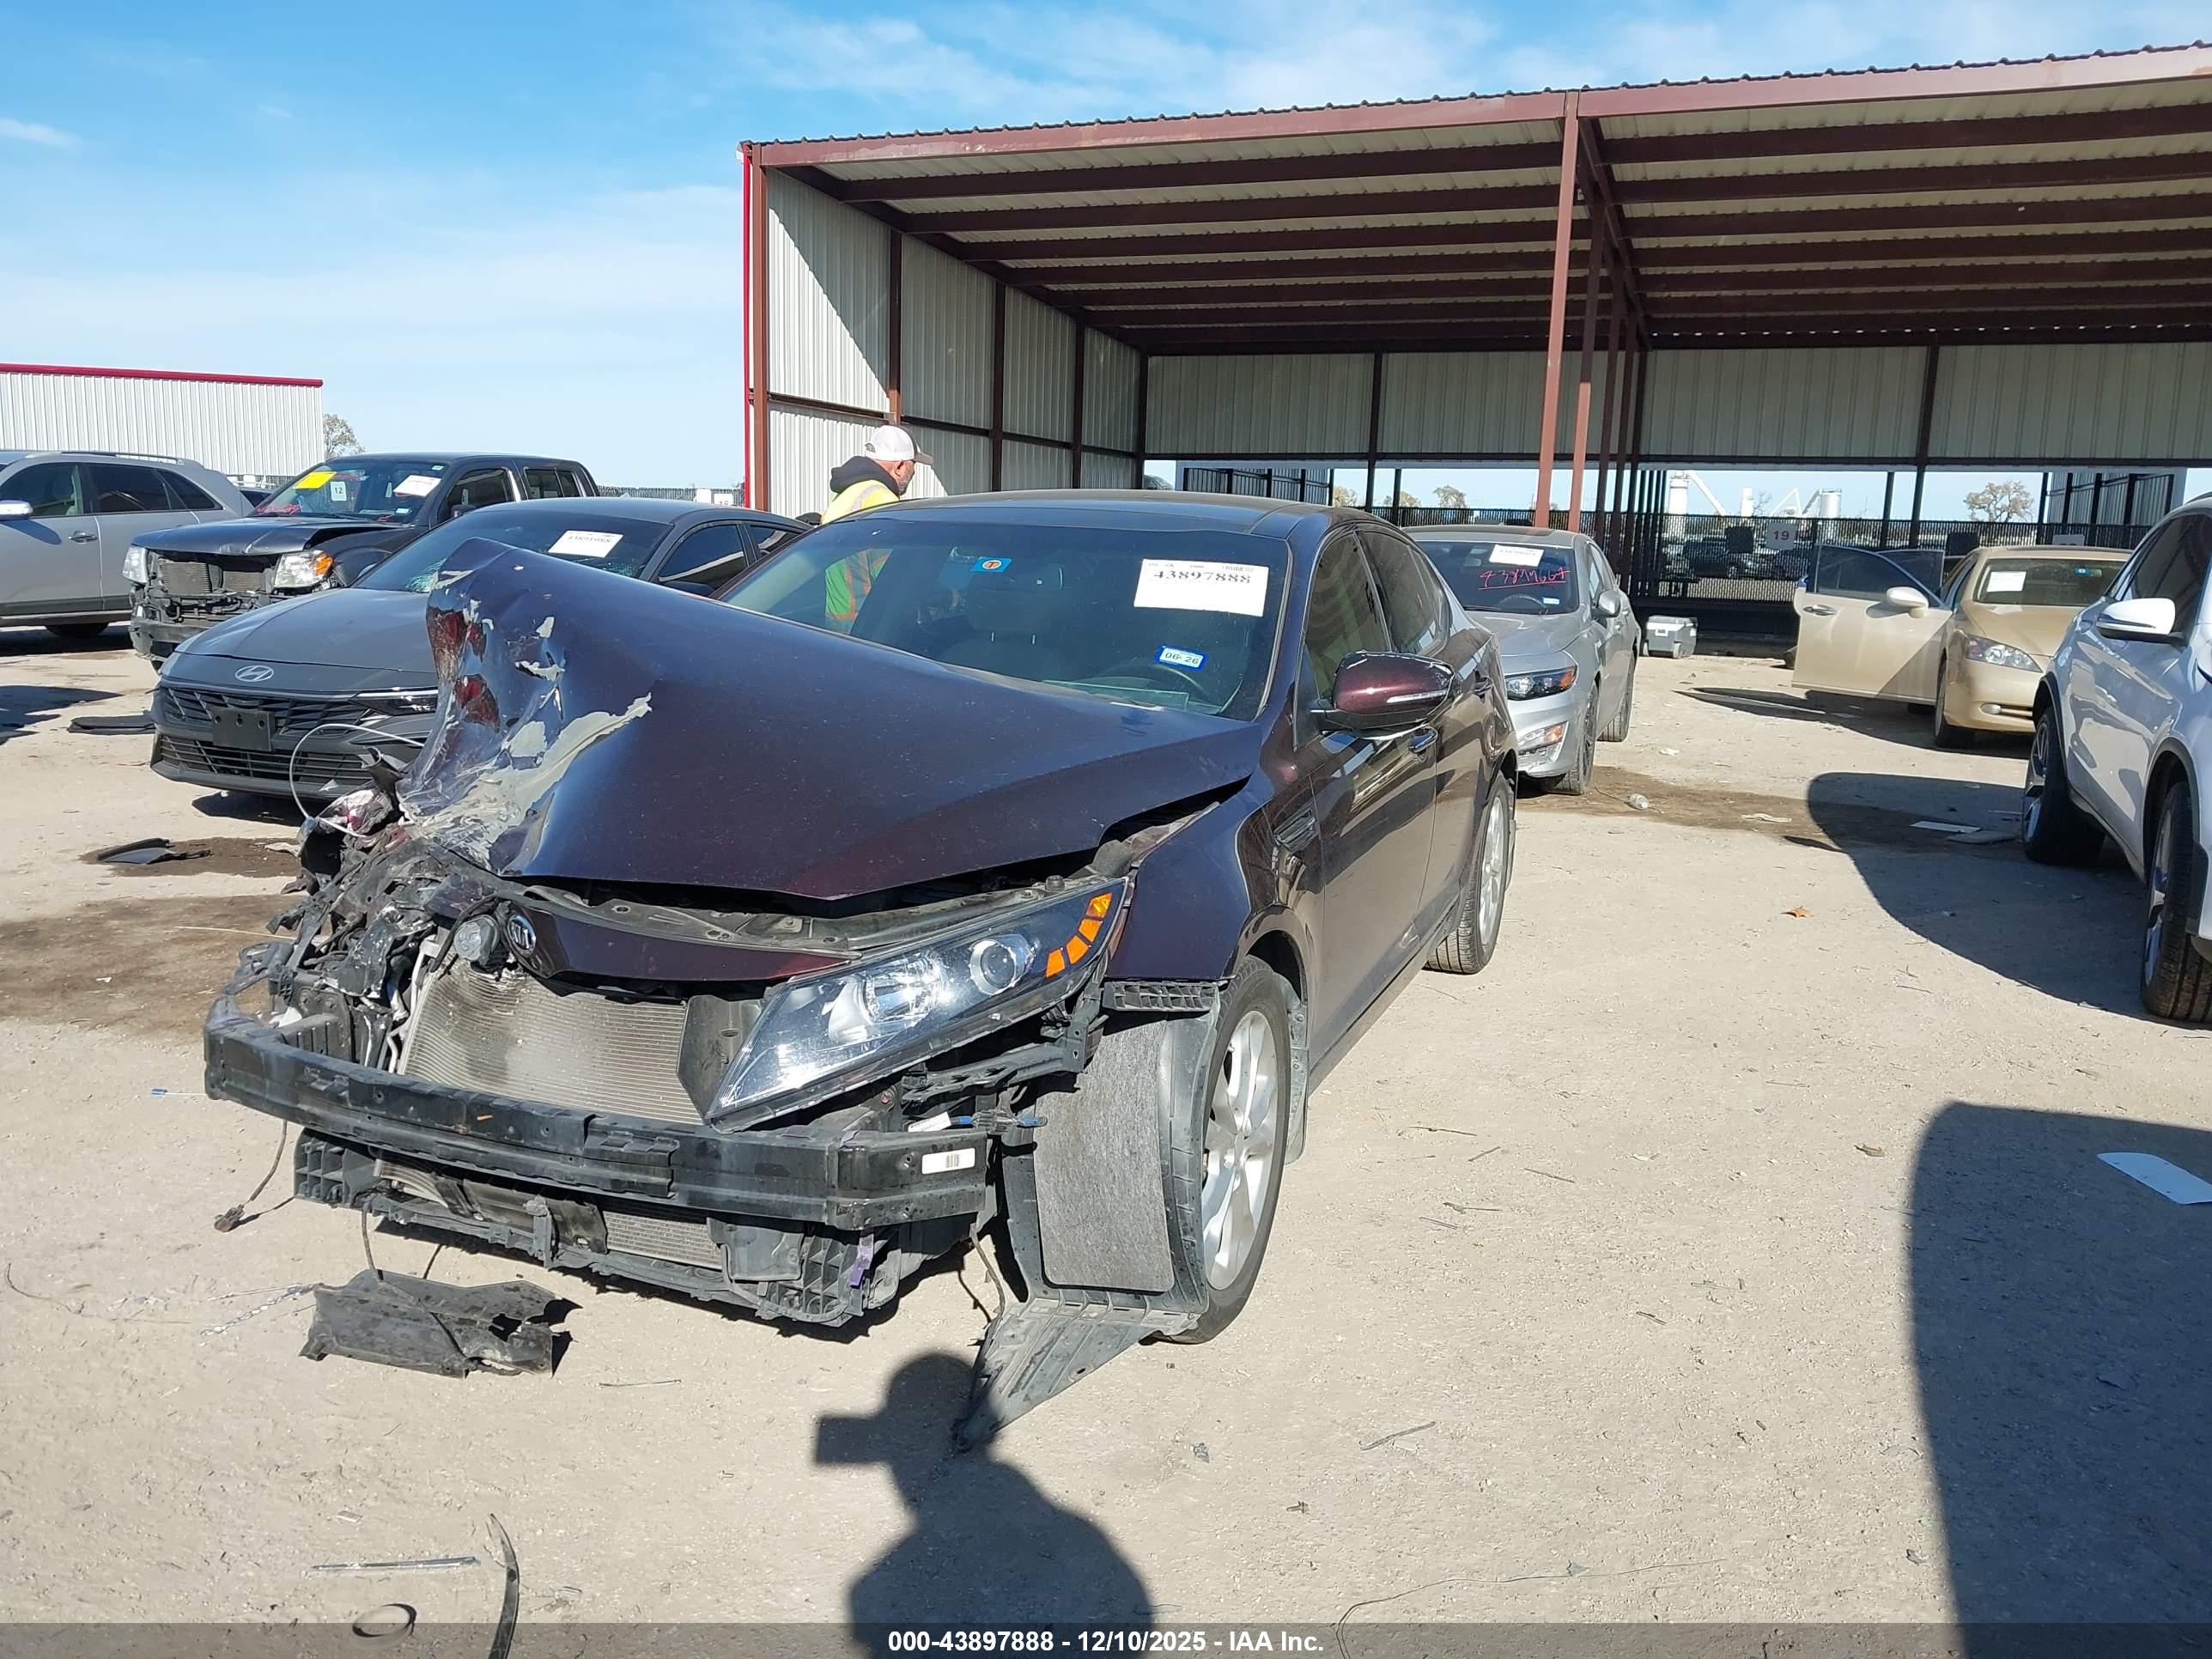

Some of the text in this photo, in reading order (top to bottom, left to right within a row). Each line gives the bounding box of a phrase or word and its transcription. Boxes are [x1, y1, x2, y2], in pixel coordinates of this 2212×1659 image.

[1772, 530, 1790, 540] 19
[1153, 570, 1251, 584] 43897888
[1184, 656, 1200, 665] 26
